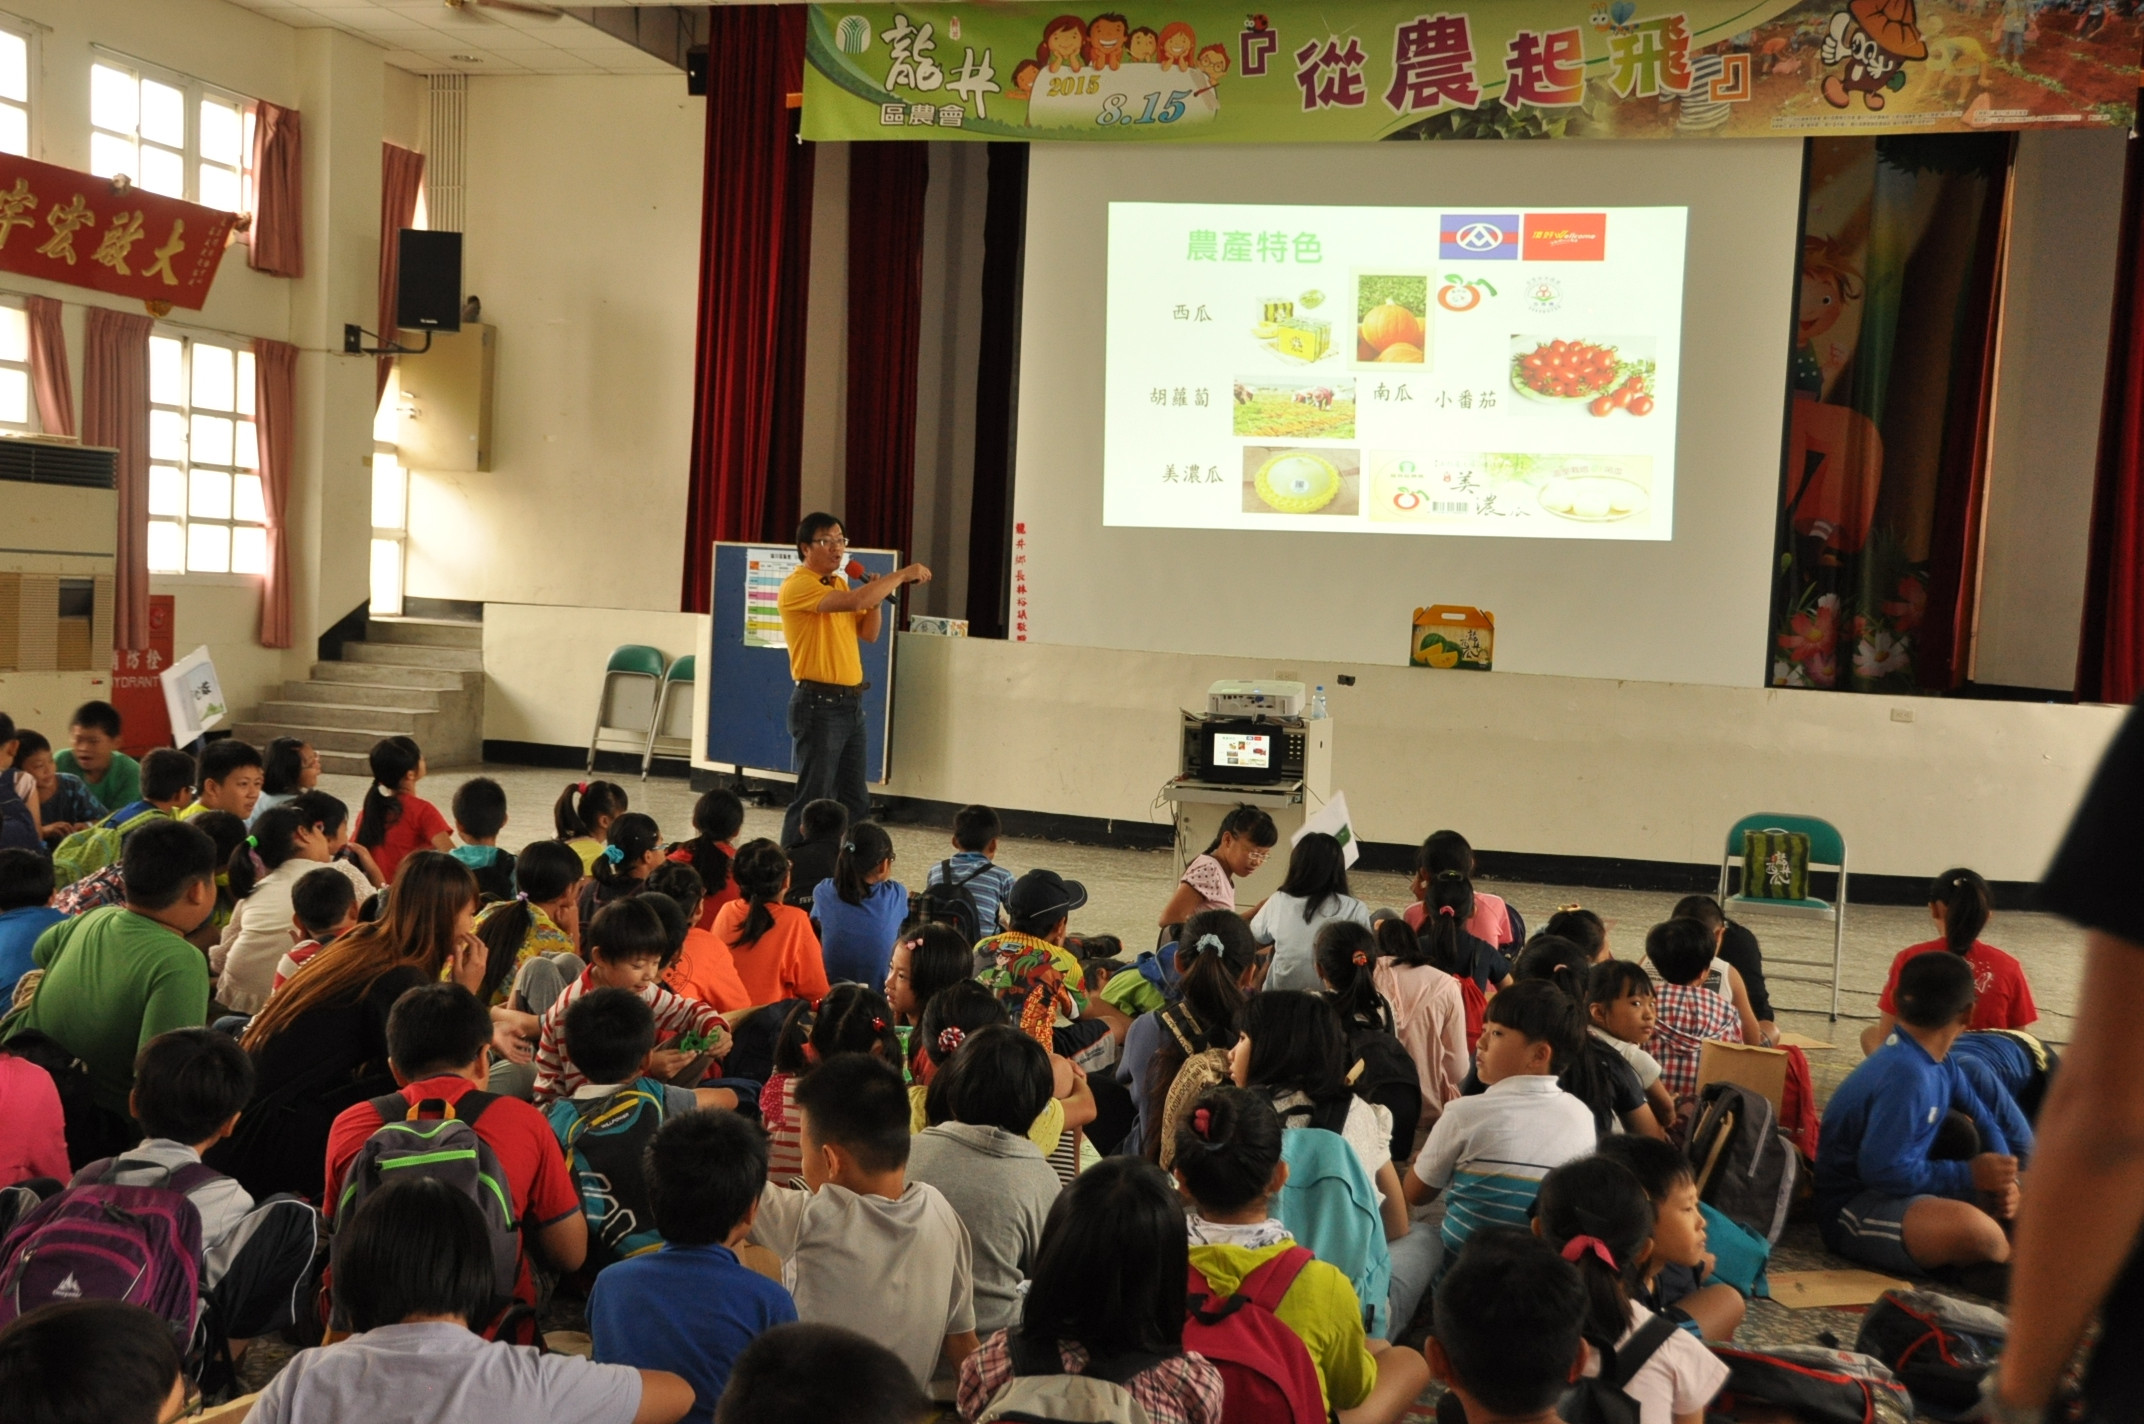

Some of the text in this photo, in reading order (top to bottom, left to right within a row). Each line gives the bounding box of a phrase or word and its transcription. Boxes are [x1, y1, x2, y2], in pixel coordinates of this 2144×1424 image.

[883, 14, 1001, 120] 龍井
[1046, 75, 1101, 98] 2015
[880, 103, 965, 128] 區農會
[1095, 89, 1193, 126] 8.15
[1186, 229, 1323, 264] 農產特色
[1172, 303, 1213, 323] 西瓜
[1149, 386, 1210, 408] 胡蘿蔔
[1373, 381, 1413, 403] 南瓜
[1434, 389, 1497, 410] 小番茄
[1162, 463, 1224, 484] 美濃瓜
[112, 676, 159, 688] YDRANT
